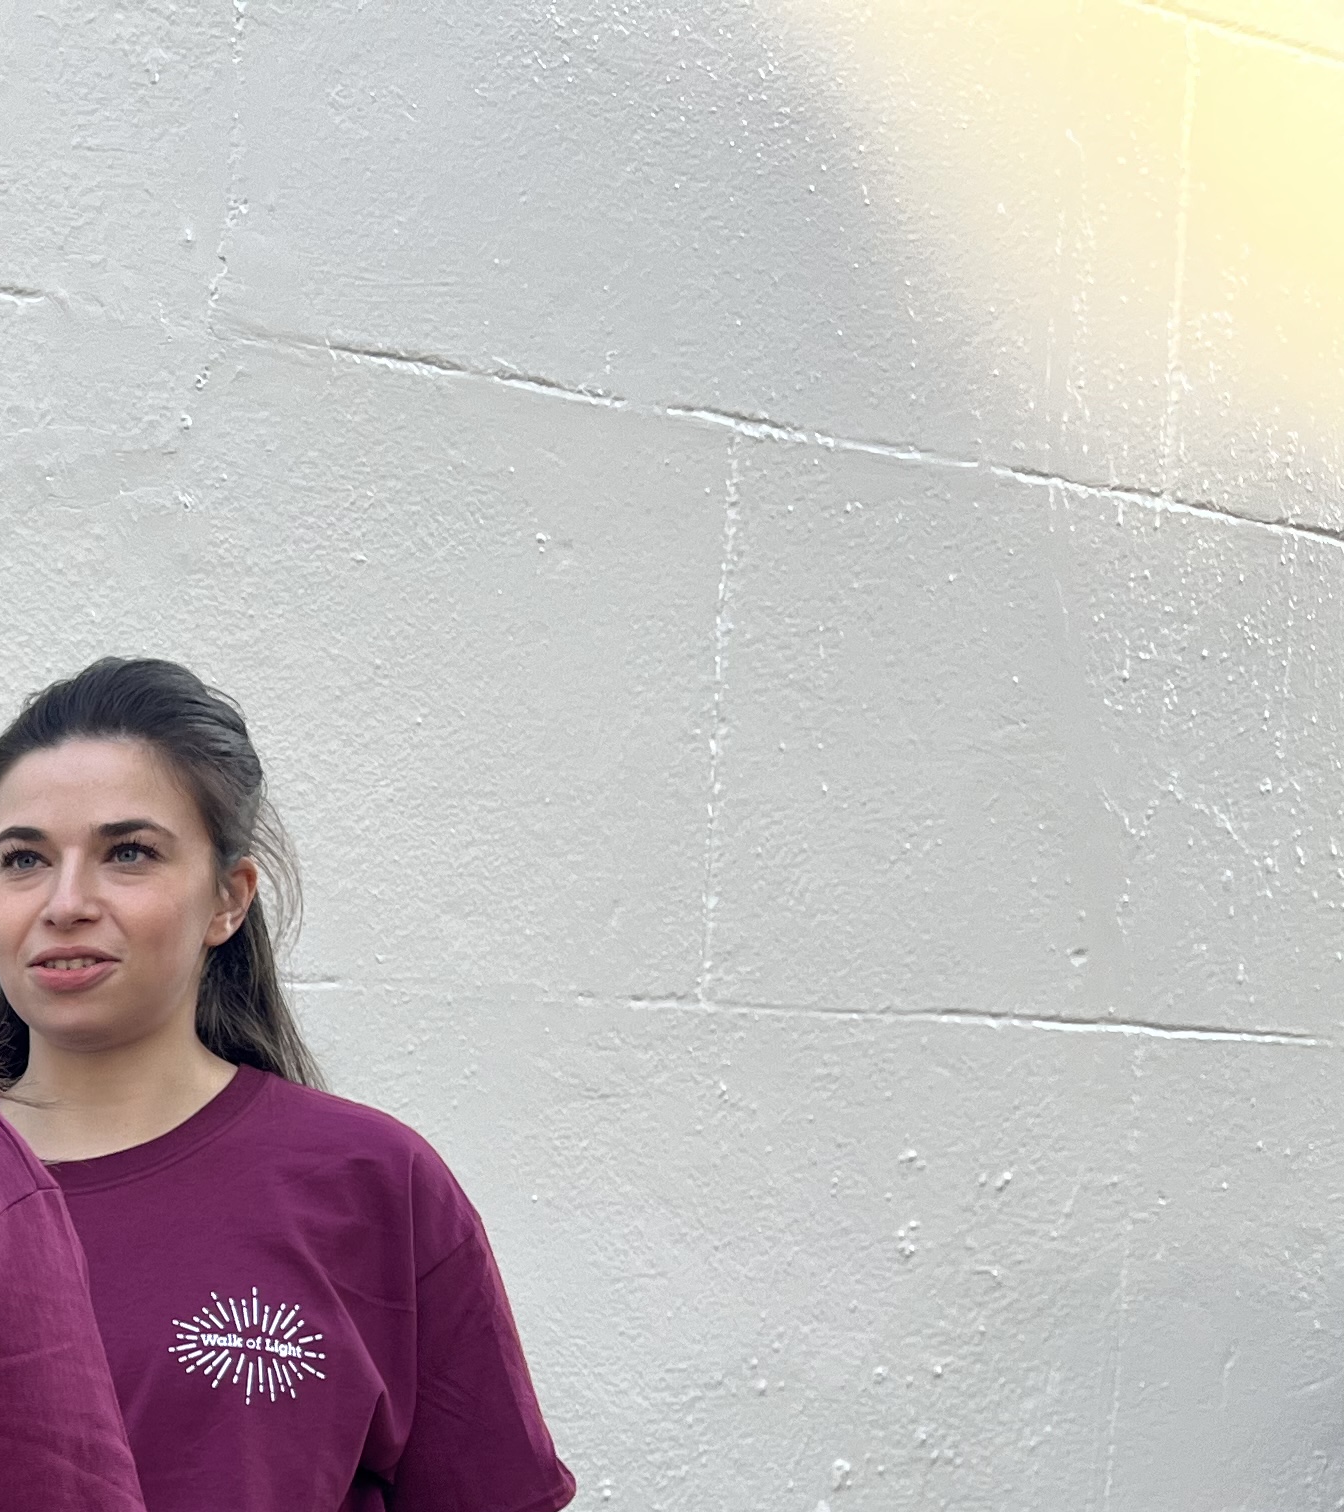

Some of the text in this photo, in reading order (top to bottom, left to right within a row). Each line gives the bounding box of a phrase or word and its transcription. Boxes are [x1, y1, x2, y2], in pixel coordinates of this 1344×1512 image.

[200, 1333, 302, 1358] Walk of Light
